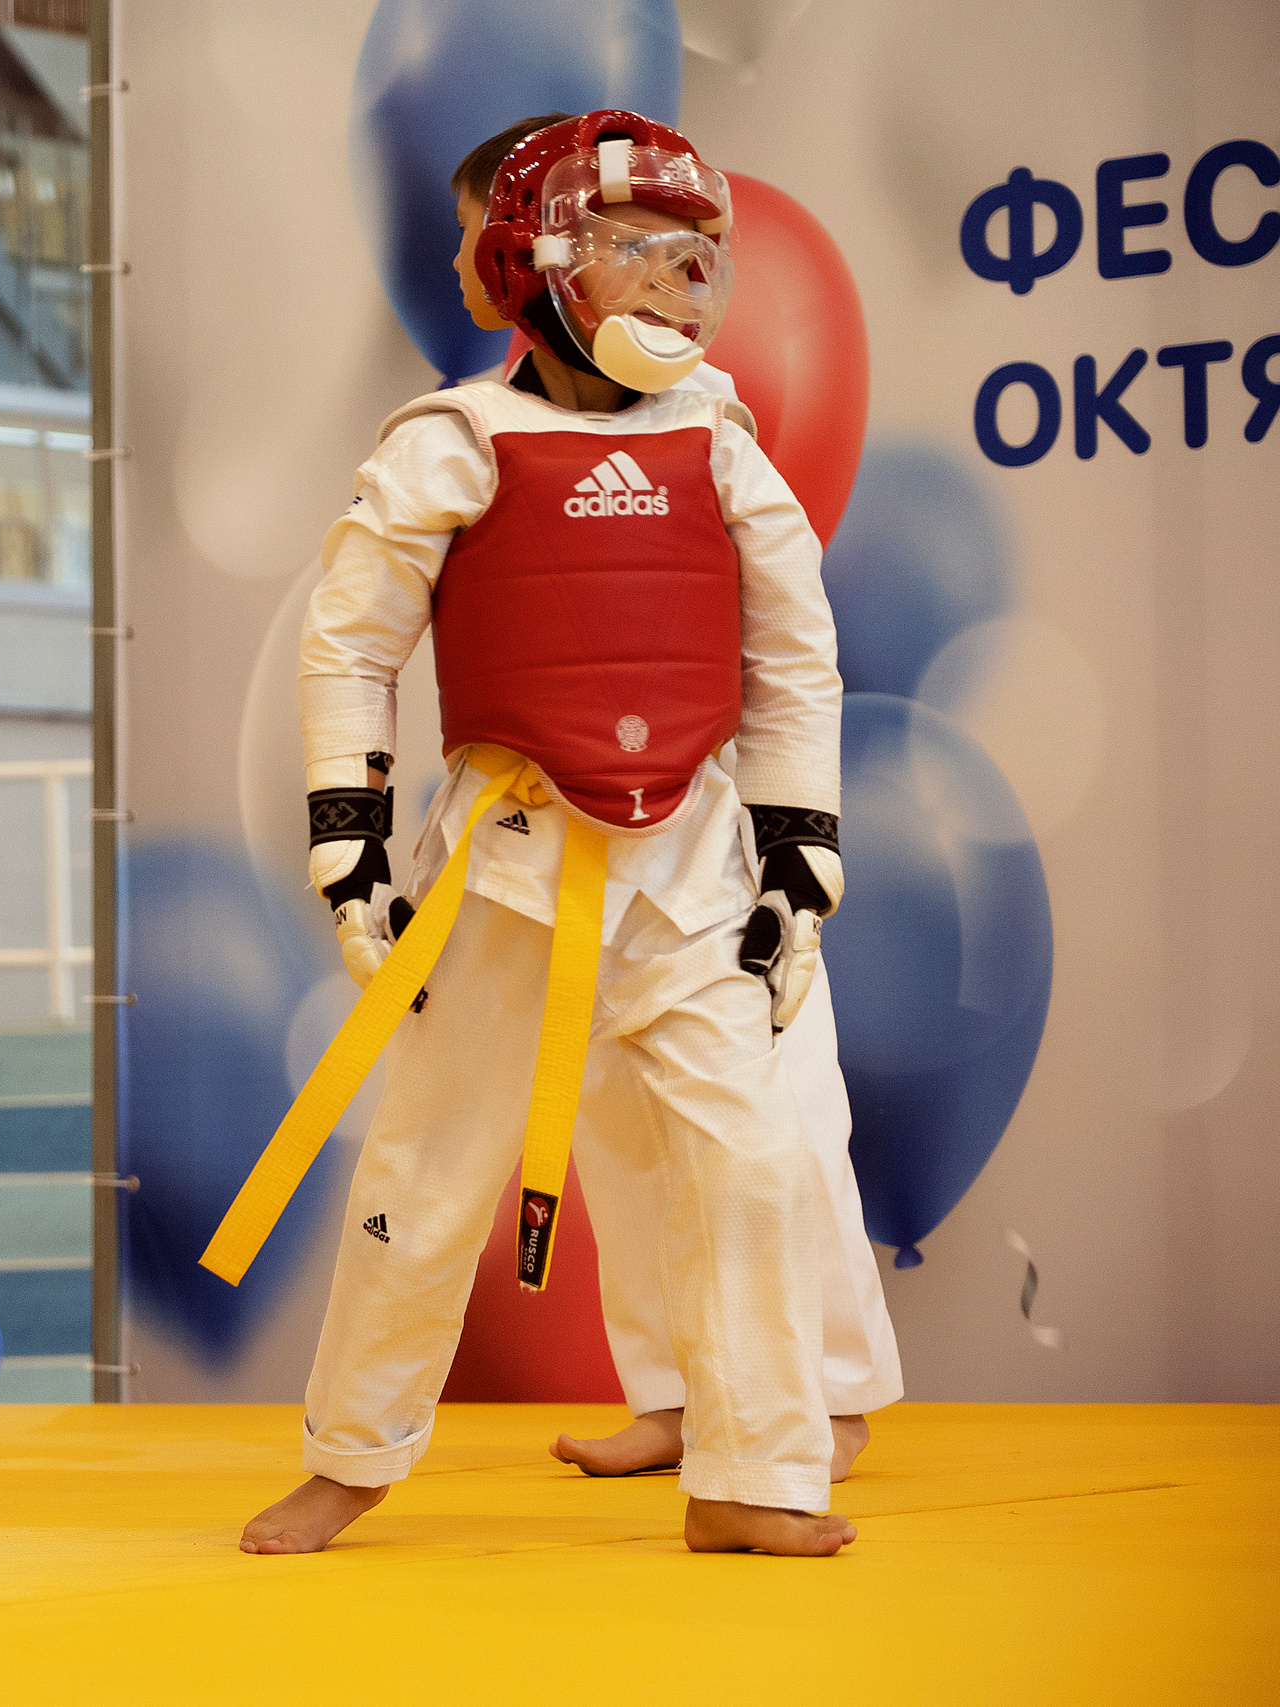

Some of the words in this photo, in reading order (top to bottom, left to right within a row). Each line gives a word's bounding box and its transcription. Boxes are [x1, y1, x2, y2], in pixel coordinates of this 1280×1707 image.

[959, 139, 1280, 295] ФЕС
[564, 489, 670, 518] adidas
[628, 788, 651, 821] 1
[526, 1228, 540, 1273] RUSCO
